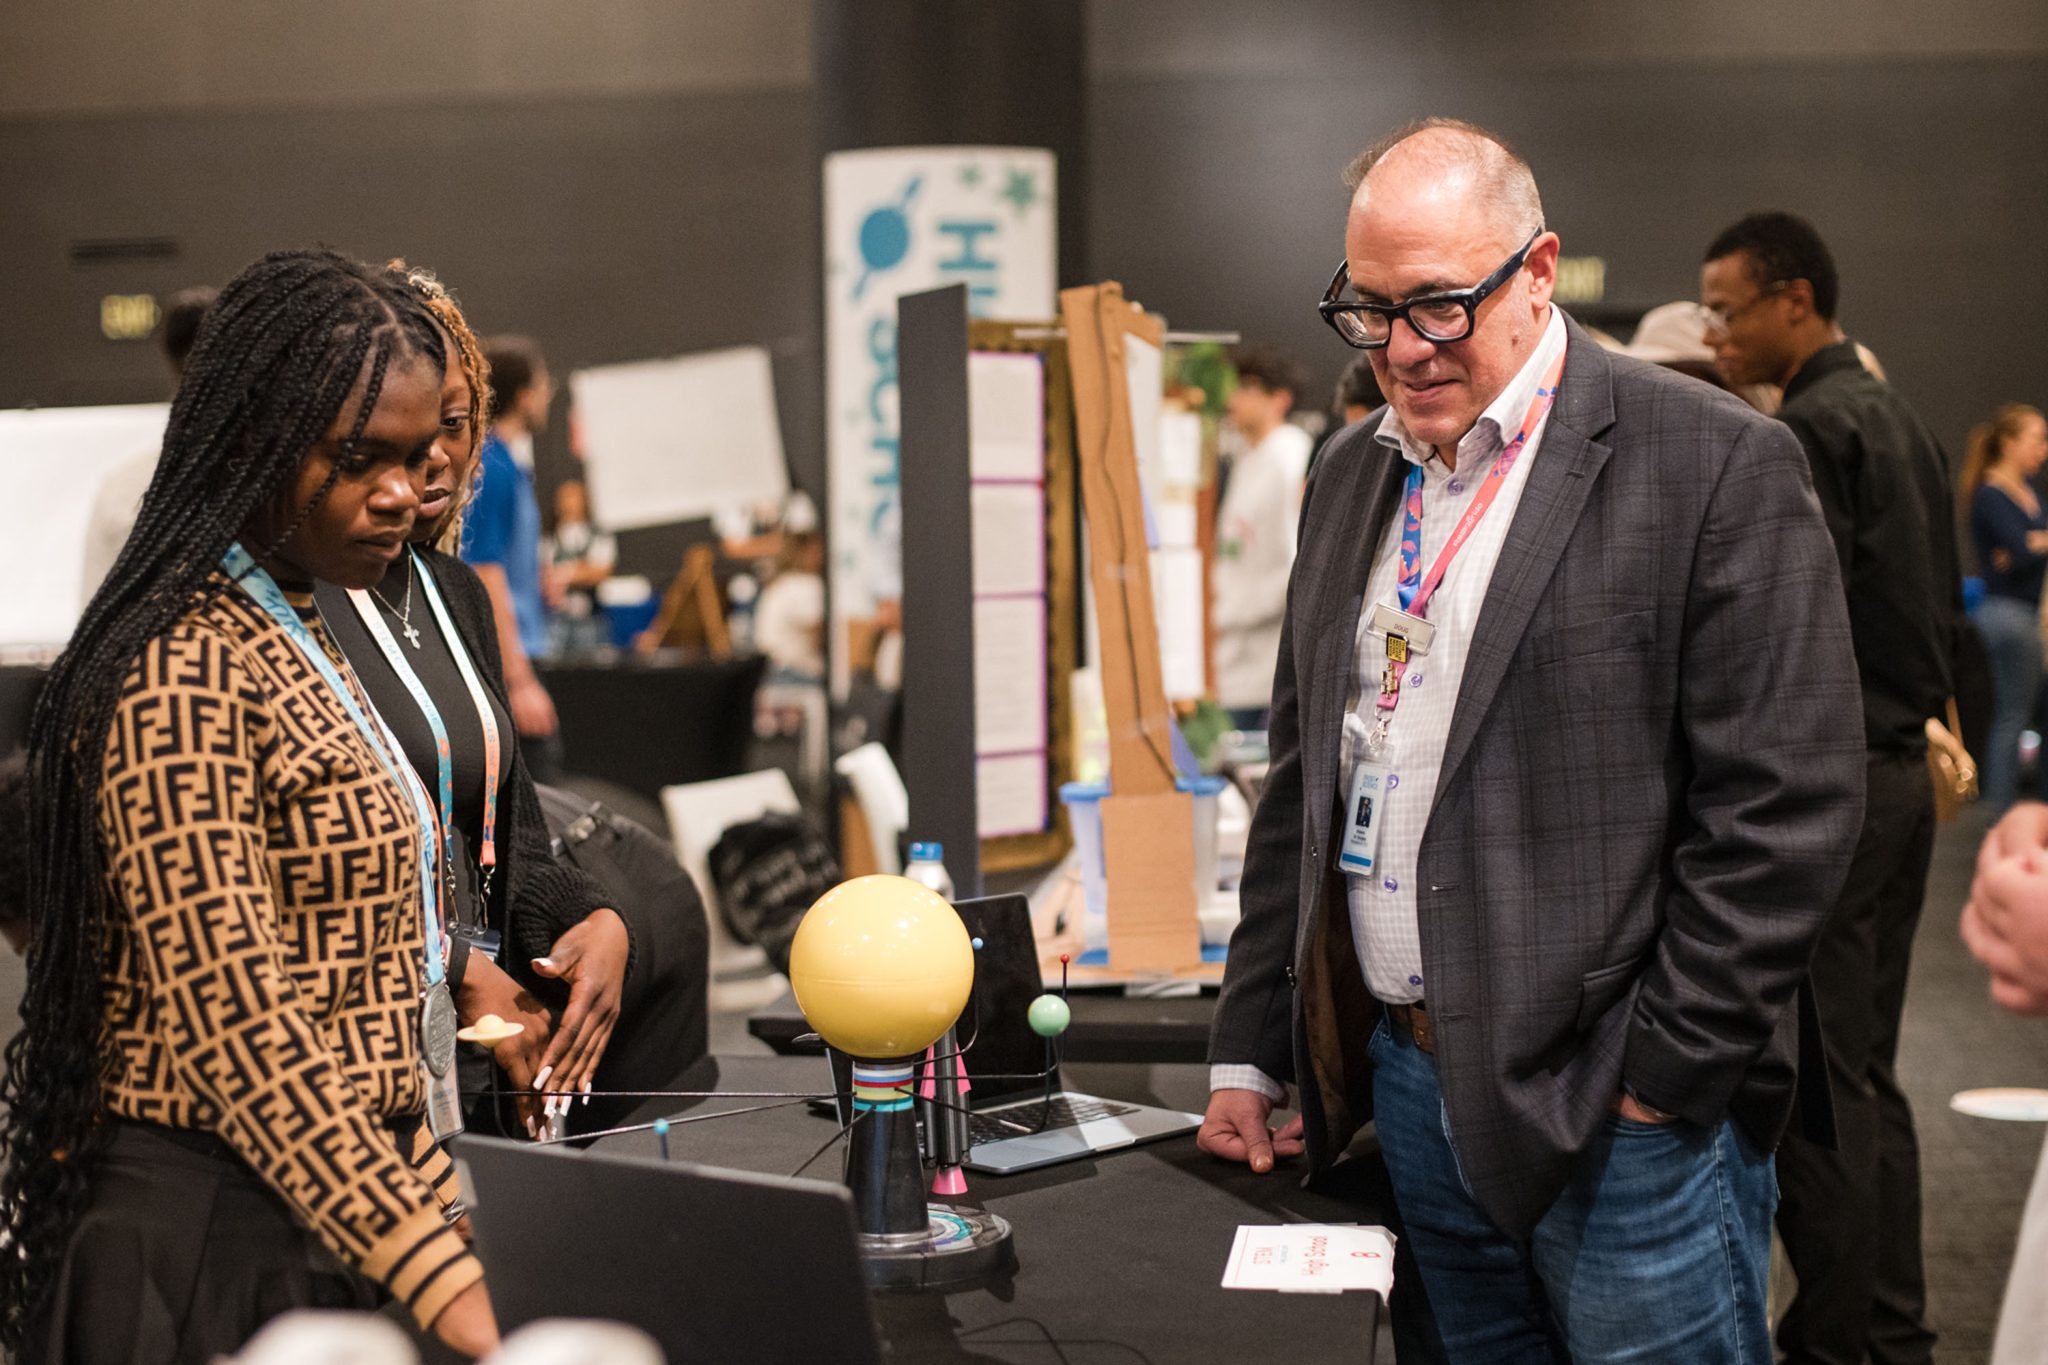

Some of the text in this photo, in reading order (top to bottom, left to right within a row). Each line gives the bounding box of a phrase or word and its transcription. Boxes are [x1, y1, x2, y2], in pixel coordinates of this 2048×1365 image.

[1393, 623, 1409, 634] DOUG
[1302, 1235, 1329, 1276] High School
[1350, 1251, 1382, 1259] 8
